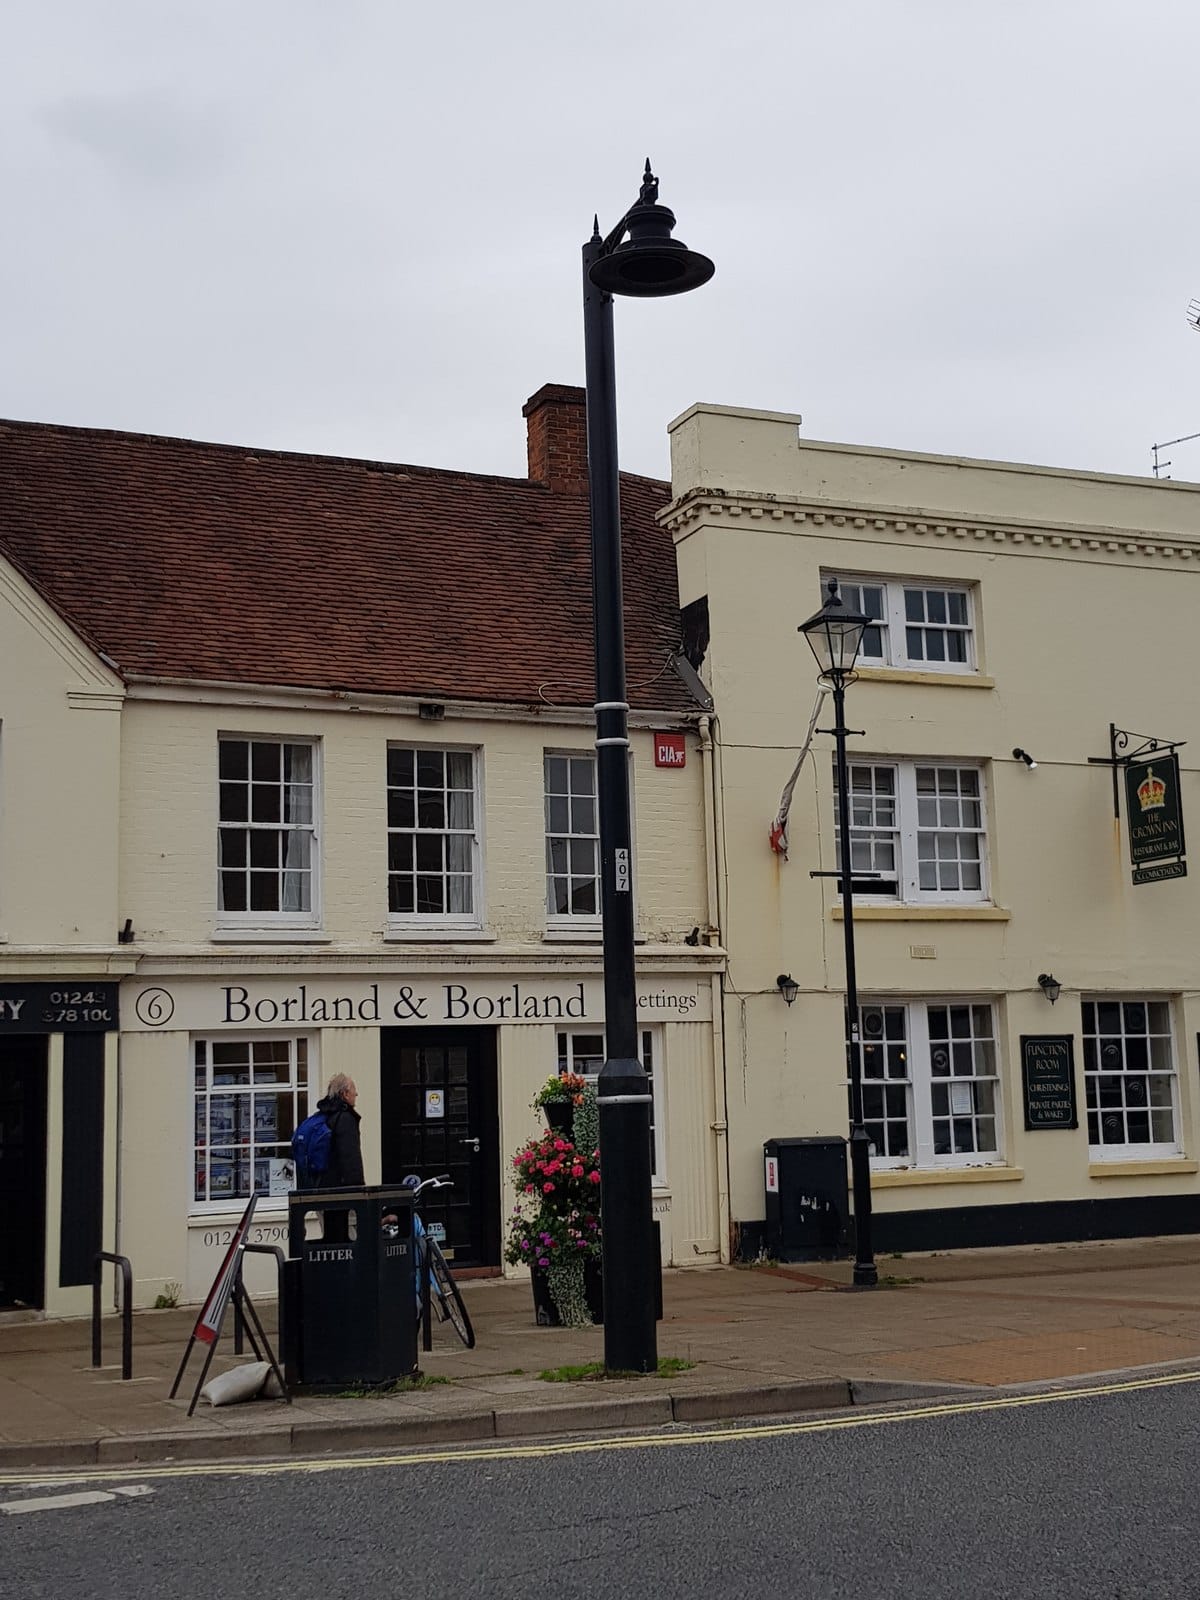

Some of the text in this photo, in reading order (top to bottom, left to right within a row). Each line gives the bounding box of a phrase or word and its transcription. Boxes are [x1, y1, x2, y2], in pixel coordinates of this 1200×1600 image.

[1147, 813, 1159, 824] THE
[1132, 820, 1178, 839] CROWN INN
[1133, 843, 1162, 856] RESTAURANT
[618, 850, 627, 889] 407
[147, 994, 163, 1019] 6
[220, 983, 588, 1023] Borland & Borland
[636, 989, 698, 1014] ettings
[1027, 1045, 1067, 1056] FUNCTION
[1036, 1060, 1060, 1070] ROOM
[1030, 1083, 1069, 1092] CHRISTENINGS
[1030, 1100, 1071, 1110] PRIVATE PARTIES
[1044, 1110, 1064, 1119] WAKES
[254, 1227, 290, 1243] 3790
[309, 1249, 354, 1262] LITTER
[385, 1244, 408, 1257] LITTER
